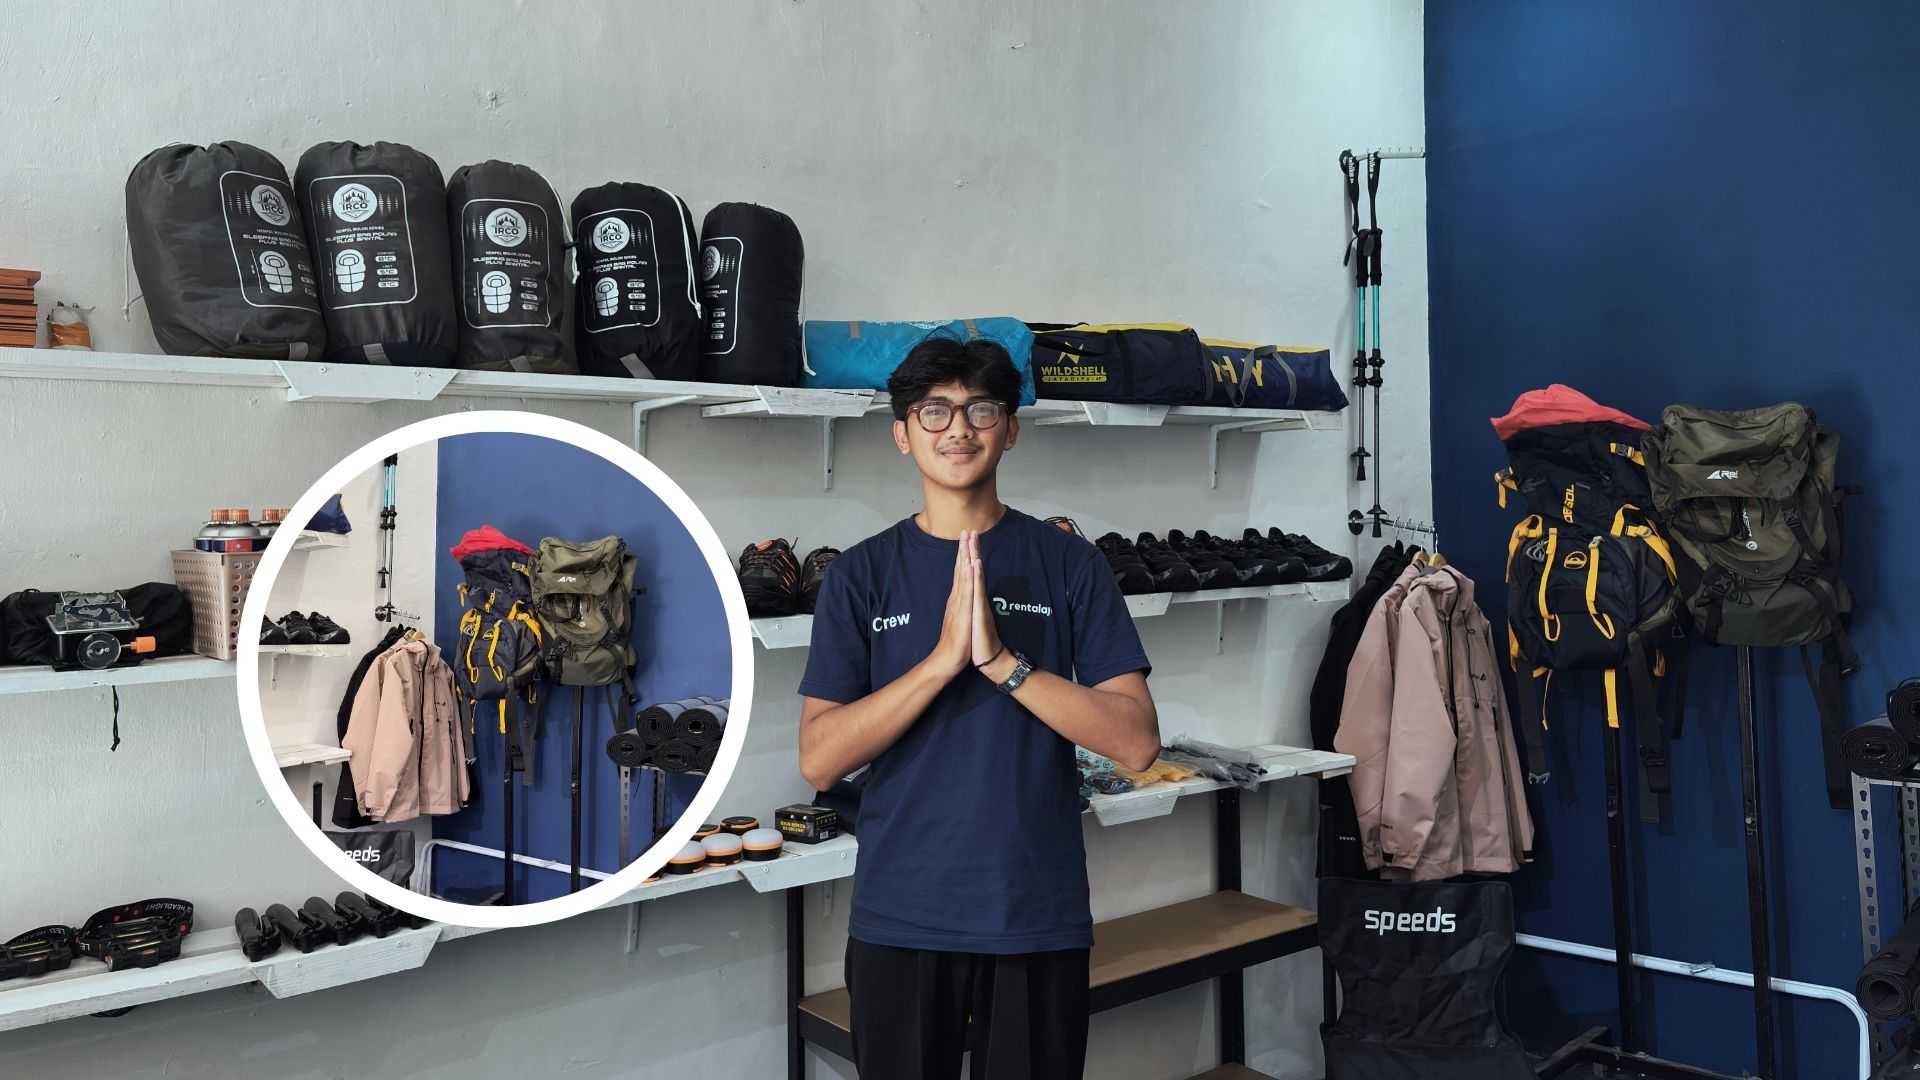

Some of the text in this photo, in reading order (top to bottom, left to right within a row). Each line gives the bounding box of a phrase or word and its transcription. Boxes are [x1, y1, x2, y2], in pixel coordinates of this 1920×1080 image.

[342, 202, 368, 211] IRCO
[495, 227, 519, 235] IRCO
[601, 233, 622, 243] IRCO
[1041, 366, 1107, 376] WILDSHELL
[1009, 602, 1053, 617] rentalaj
[872, 612, 911, 632] Crew
[344, 844, 381, 862] eeds
[145, 902, 186, 912] HEADLIGHT
[1364, 906, 1457, 936] speeds
